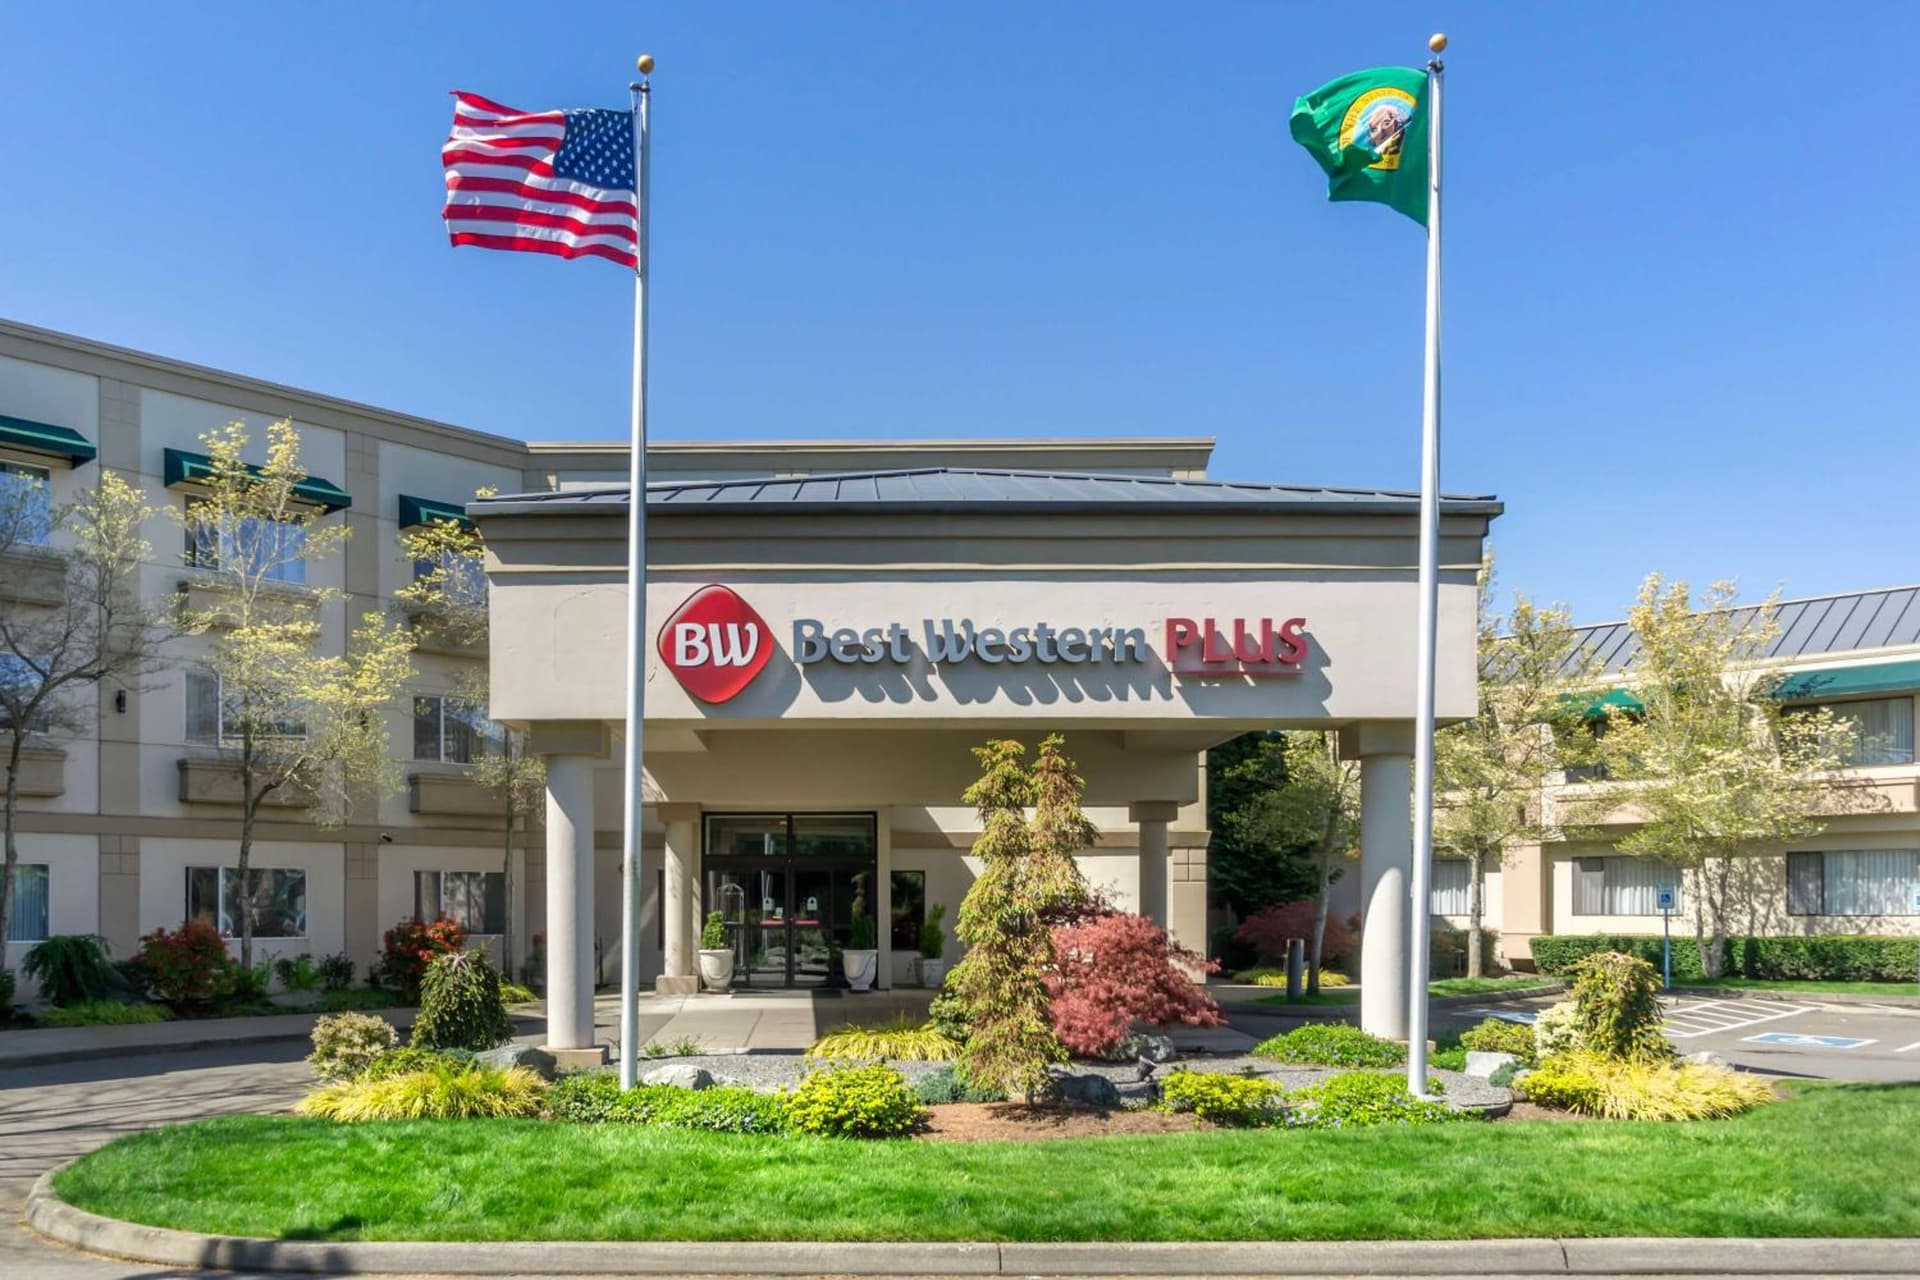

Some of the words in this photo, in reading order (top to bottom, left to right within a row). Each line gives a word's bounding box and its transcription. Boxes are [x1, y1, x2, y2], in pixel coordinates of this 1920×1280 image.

[675, 622, 761, 667] BW
[792, 618, 913, 665] Best
[922, 618, 1147, 665] Western
[1165, 617, 1309, 664] PLUS
